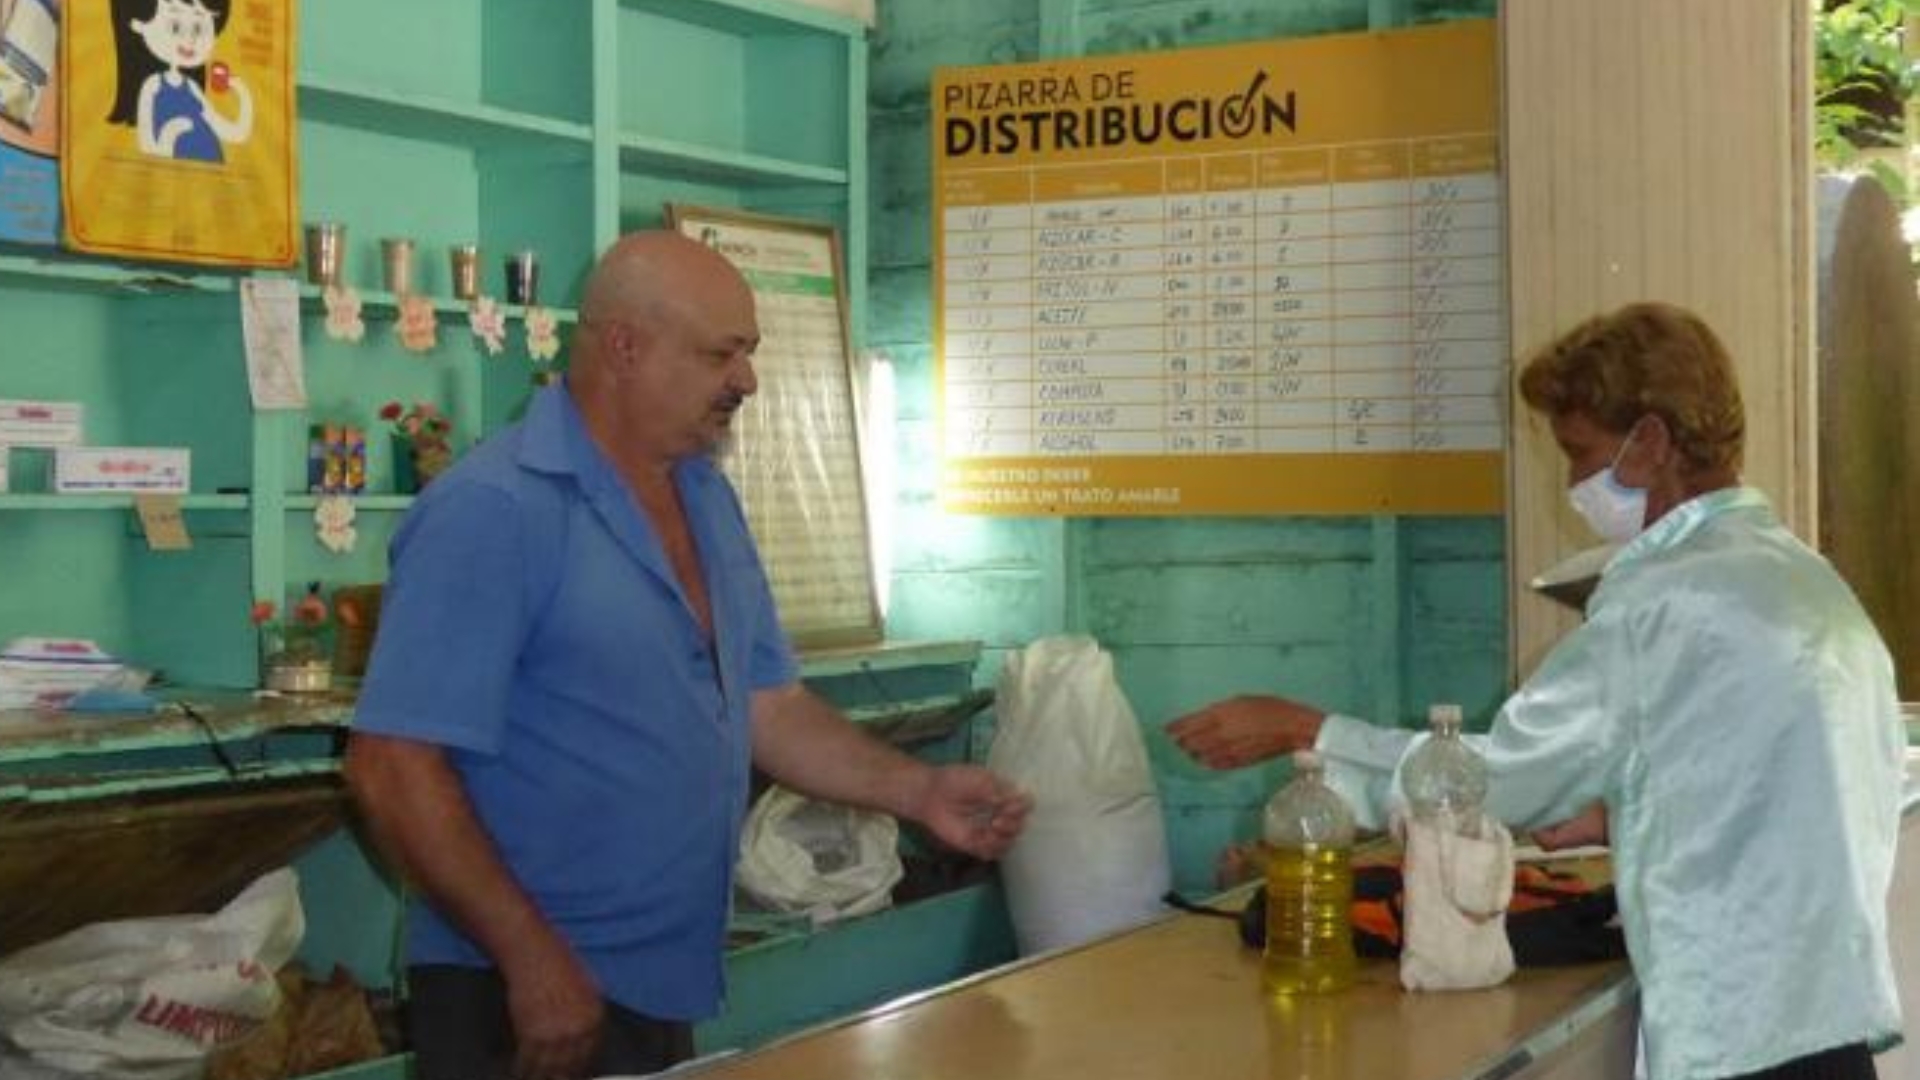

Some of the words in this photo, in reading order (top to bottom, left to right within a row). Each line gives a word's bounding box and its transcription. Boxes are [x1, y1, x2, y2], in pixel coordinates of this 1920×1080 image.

[944, 78, 1082, 112] PIZARRA
[1091, 71, 1135, 99] DE
[1062, 485, 1114, 504] TRATO
